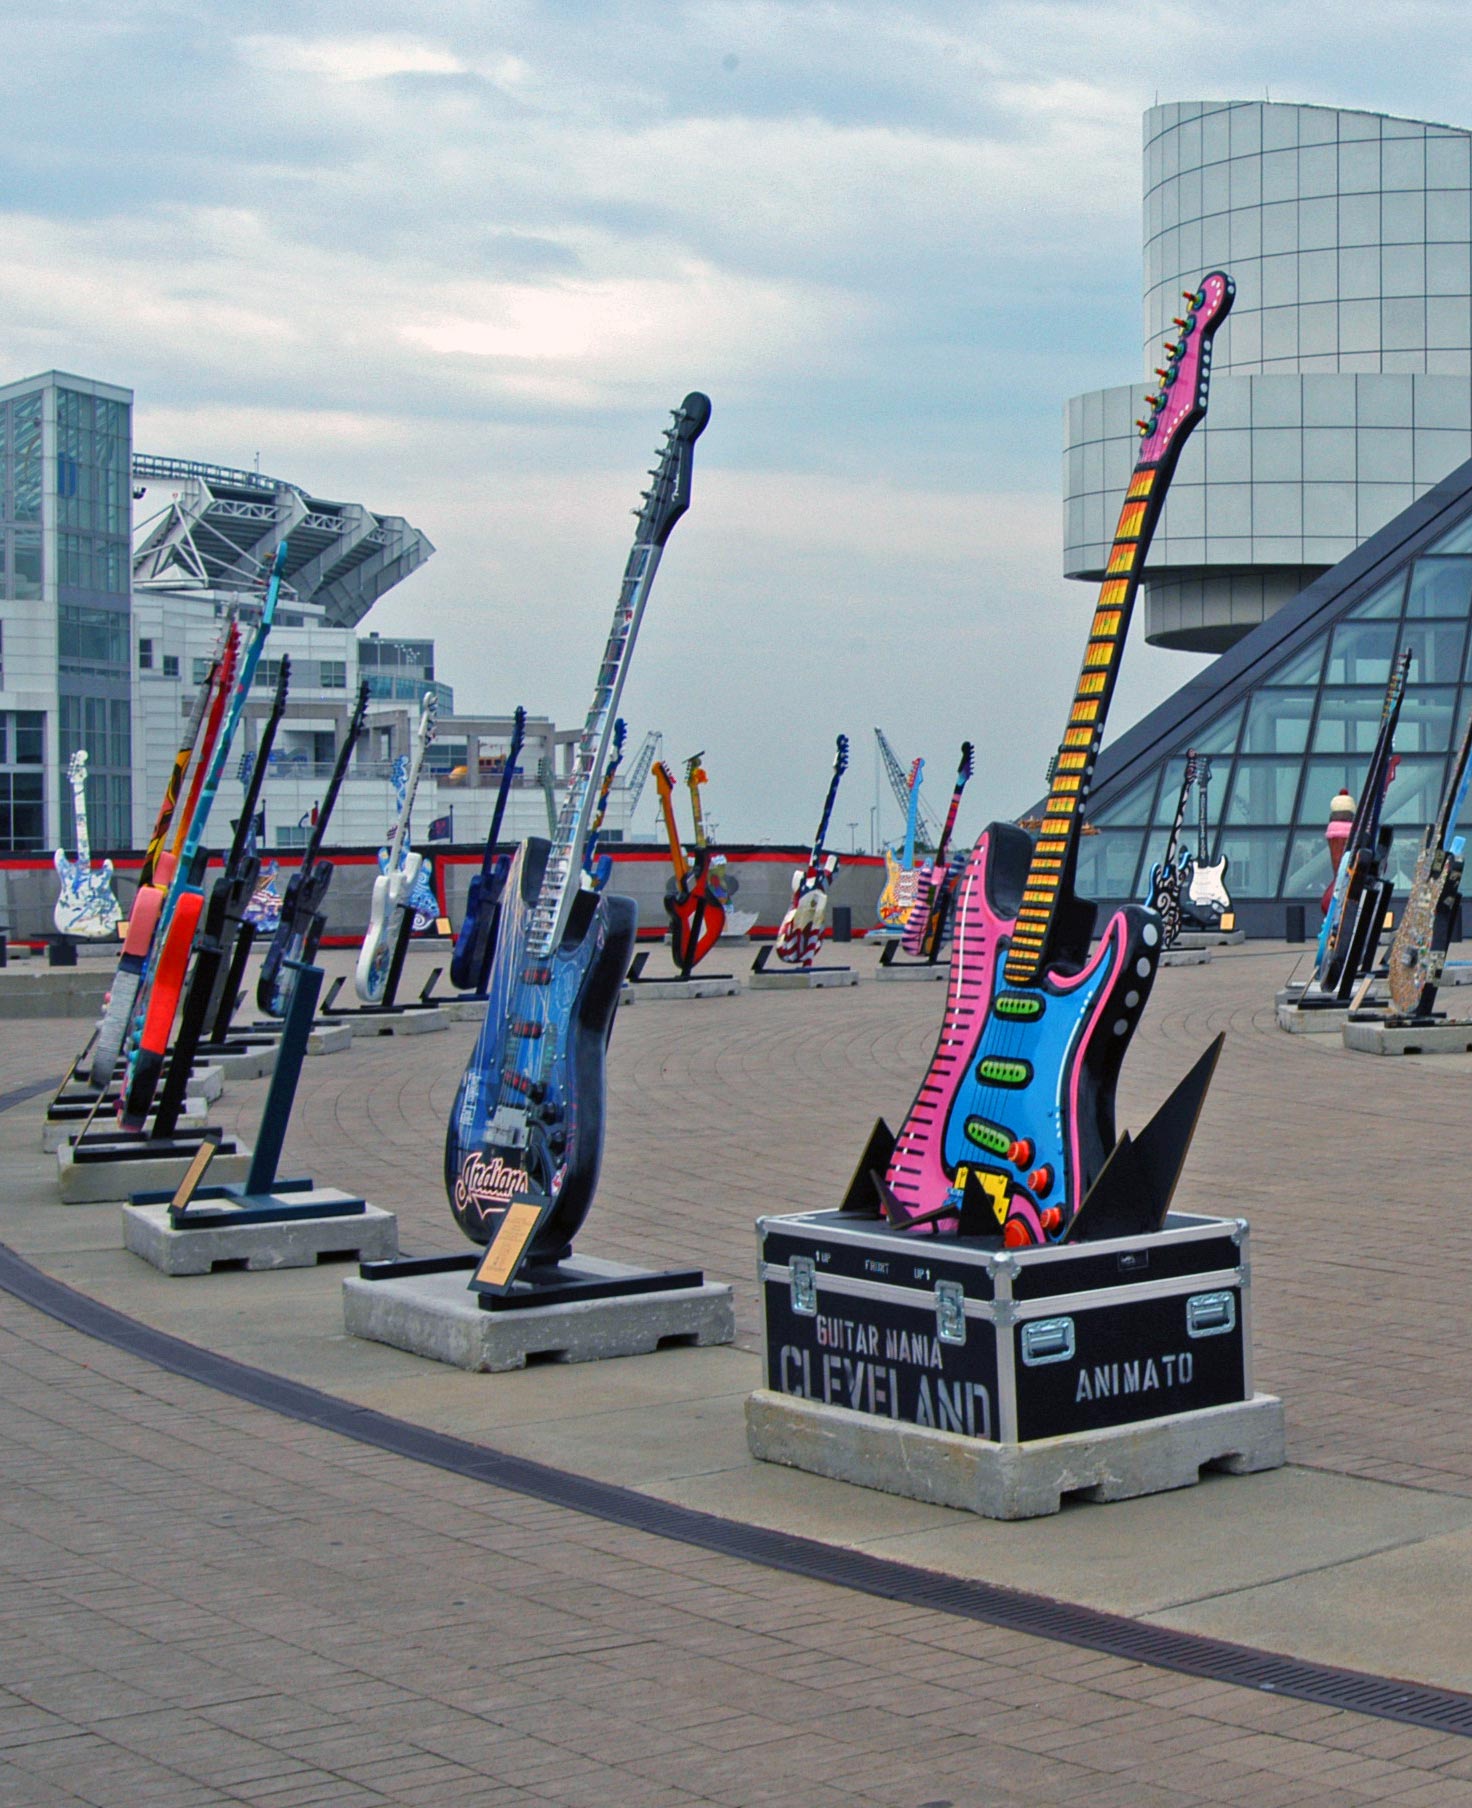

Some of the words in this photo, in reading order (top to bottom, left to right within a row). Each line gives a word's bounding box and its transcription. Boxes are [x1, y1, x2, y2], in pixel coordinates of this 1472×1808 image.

[816, 1314, 879, 1357] GUITAR
[886, 1328, 944, 1371] MANIA
[780, 1344, 992, 1441] CLEVELAND
[1075, 1352, 1193, 1403] ANIMATO
